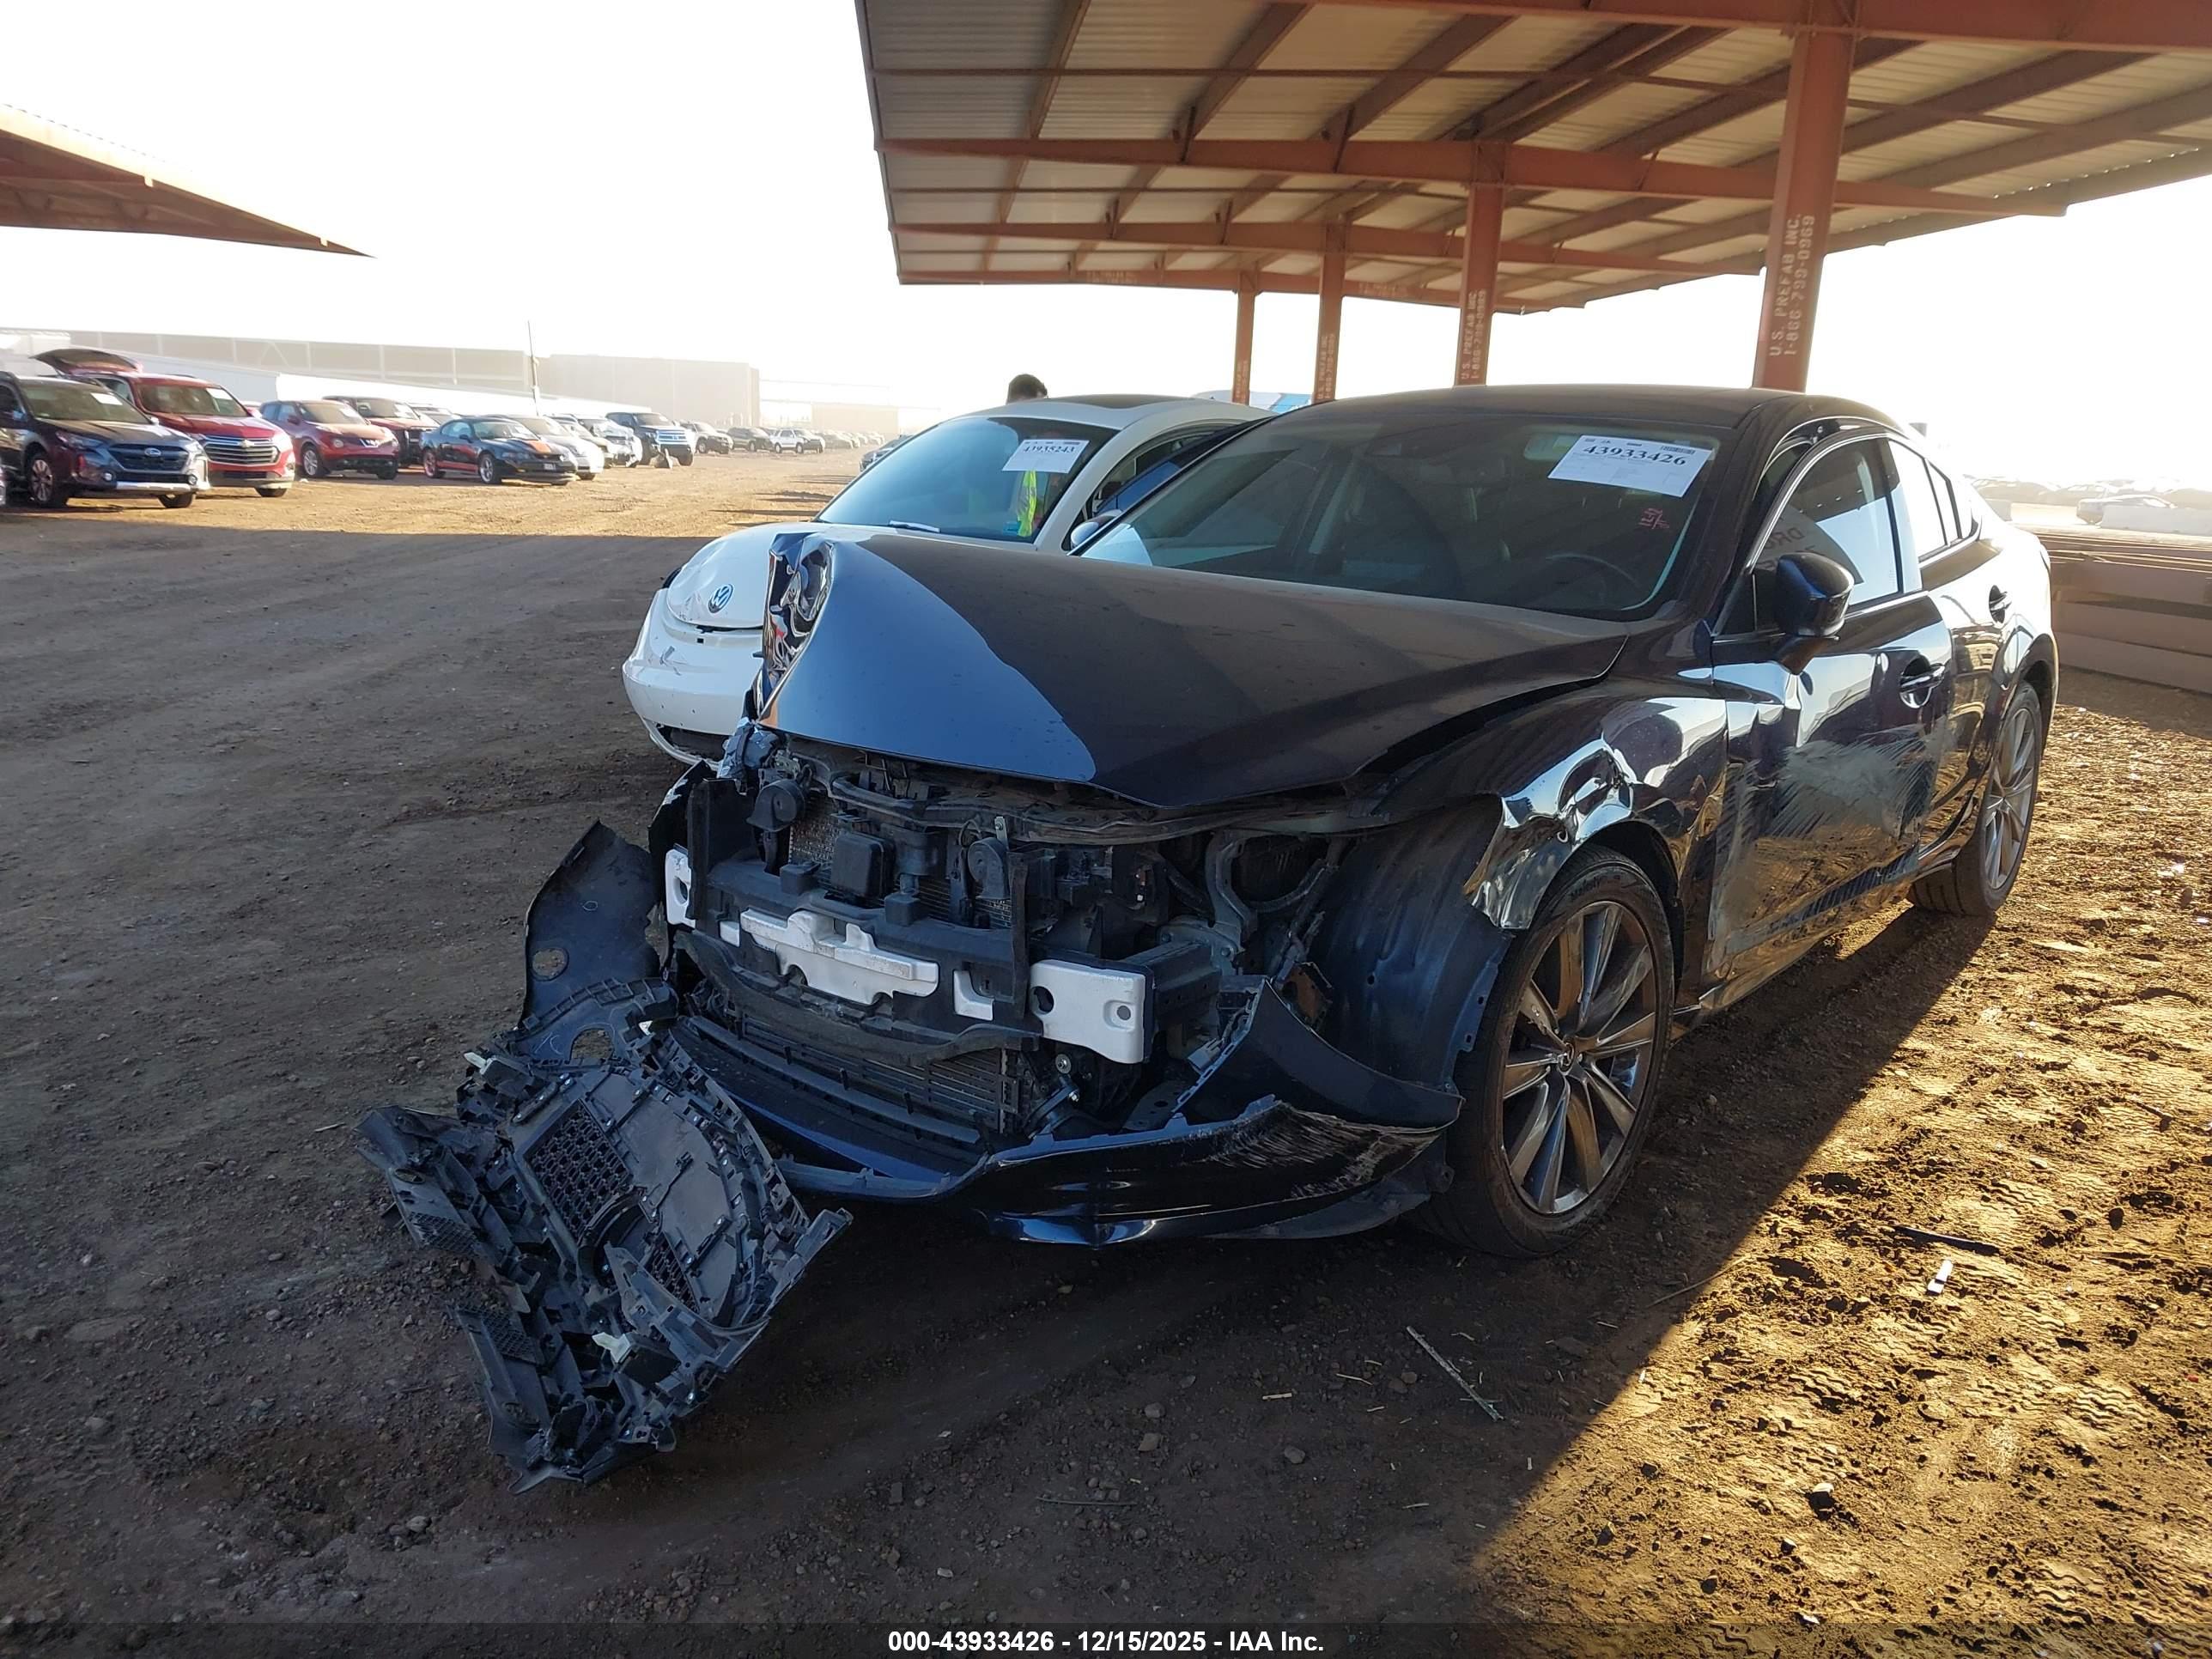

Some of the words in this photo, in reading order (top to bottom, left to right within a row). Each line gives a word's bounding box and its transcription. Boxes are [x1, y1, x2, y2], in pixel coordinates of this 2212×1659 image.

[1784, 214, 1802, 246] INC.
[1774, 253, 1796, 317] PREFAB
[1769, 326, 1785, 356] U.S.
[1583, 445, 1686, 465] 43933426
